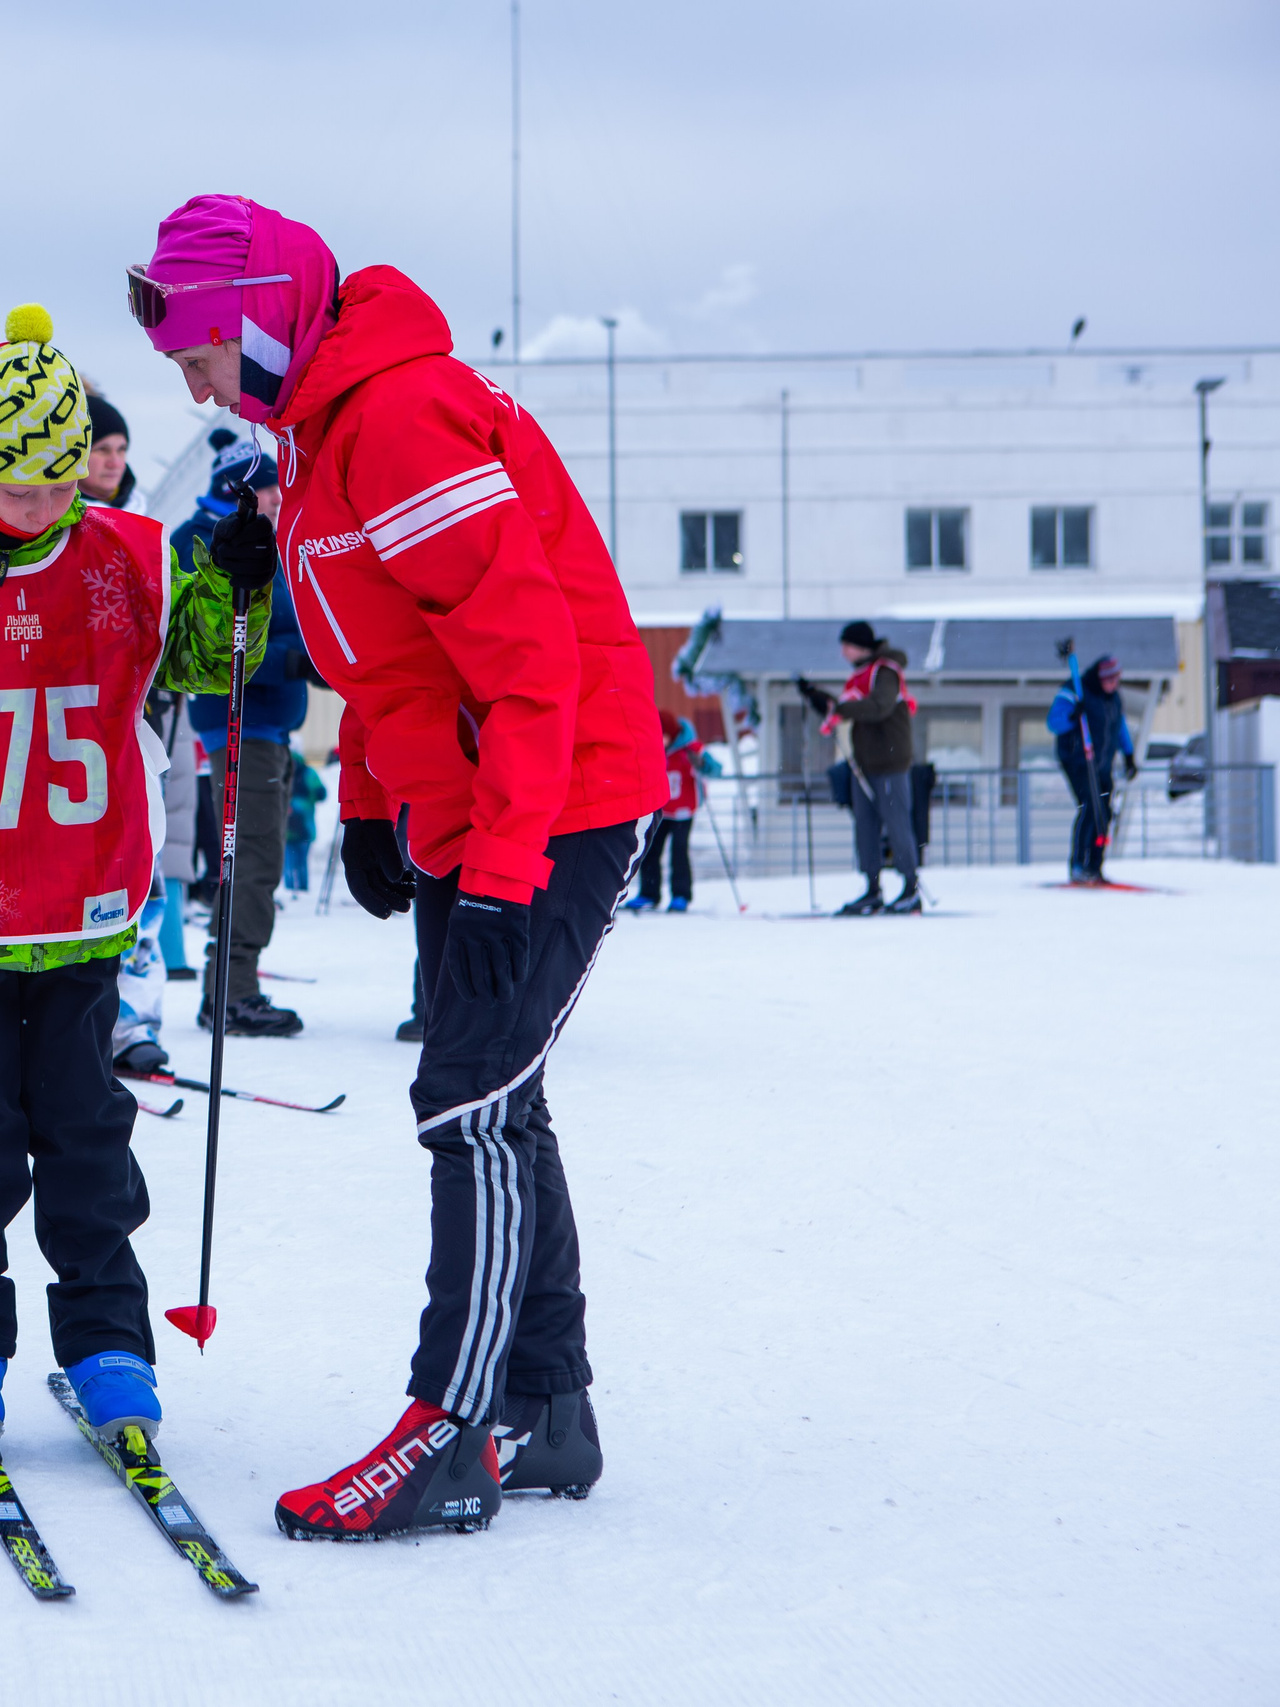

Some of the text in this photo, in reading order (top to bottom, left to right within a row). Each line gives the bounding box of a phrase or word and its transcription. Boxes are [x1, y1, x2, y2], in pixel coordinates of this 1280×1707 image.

[6, 614, 40, 626] ЛЫЖНЯ
[4, 625, 43, 641] ГЕРОЕВ
[233, 615, 248, 654] TREK
[228, 717, 240, 763] TOP
[222, 822, 235, 858] TREK
[465, 901, 502, 913] NORDSKI
[334, 1418, 460, 1516] alpina
[444, 1500, 460, 1509] PRO
[463, 1496, 481, 1516] XC
